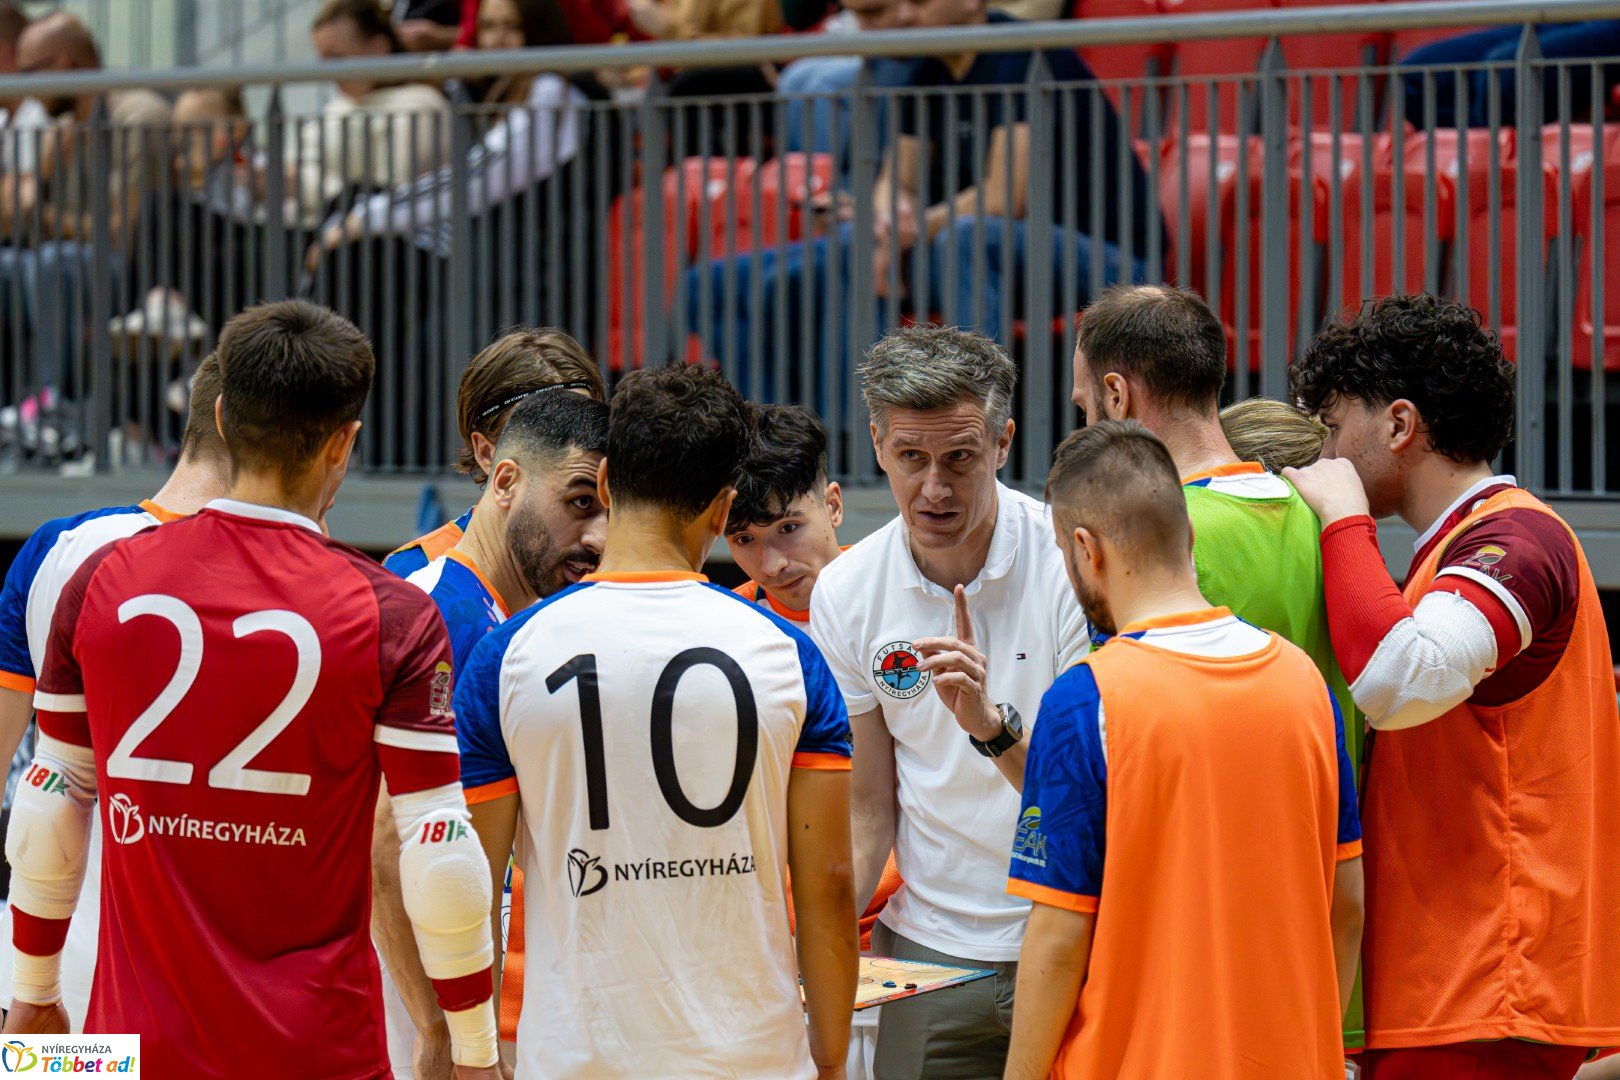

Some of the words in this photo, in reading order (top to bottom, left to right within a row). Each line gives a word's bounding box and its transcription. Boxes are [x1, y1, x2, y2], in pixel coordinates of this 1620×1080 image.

[106, 594, 322, 796] 22
[545, 646, 759, 831] 10
[148, 813, 307, 847] NYÍREGYHÁZA
[614, 852, 756, 881] NYÍREGYHÁZA
